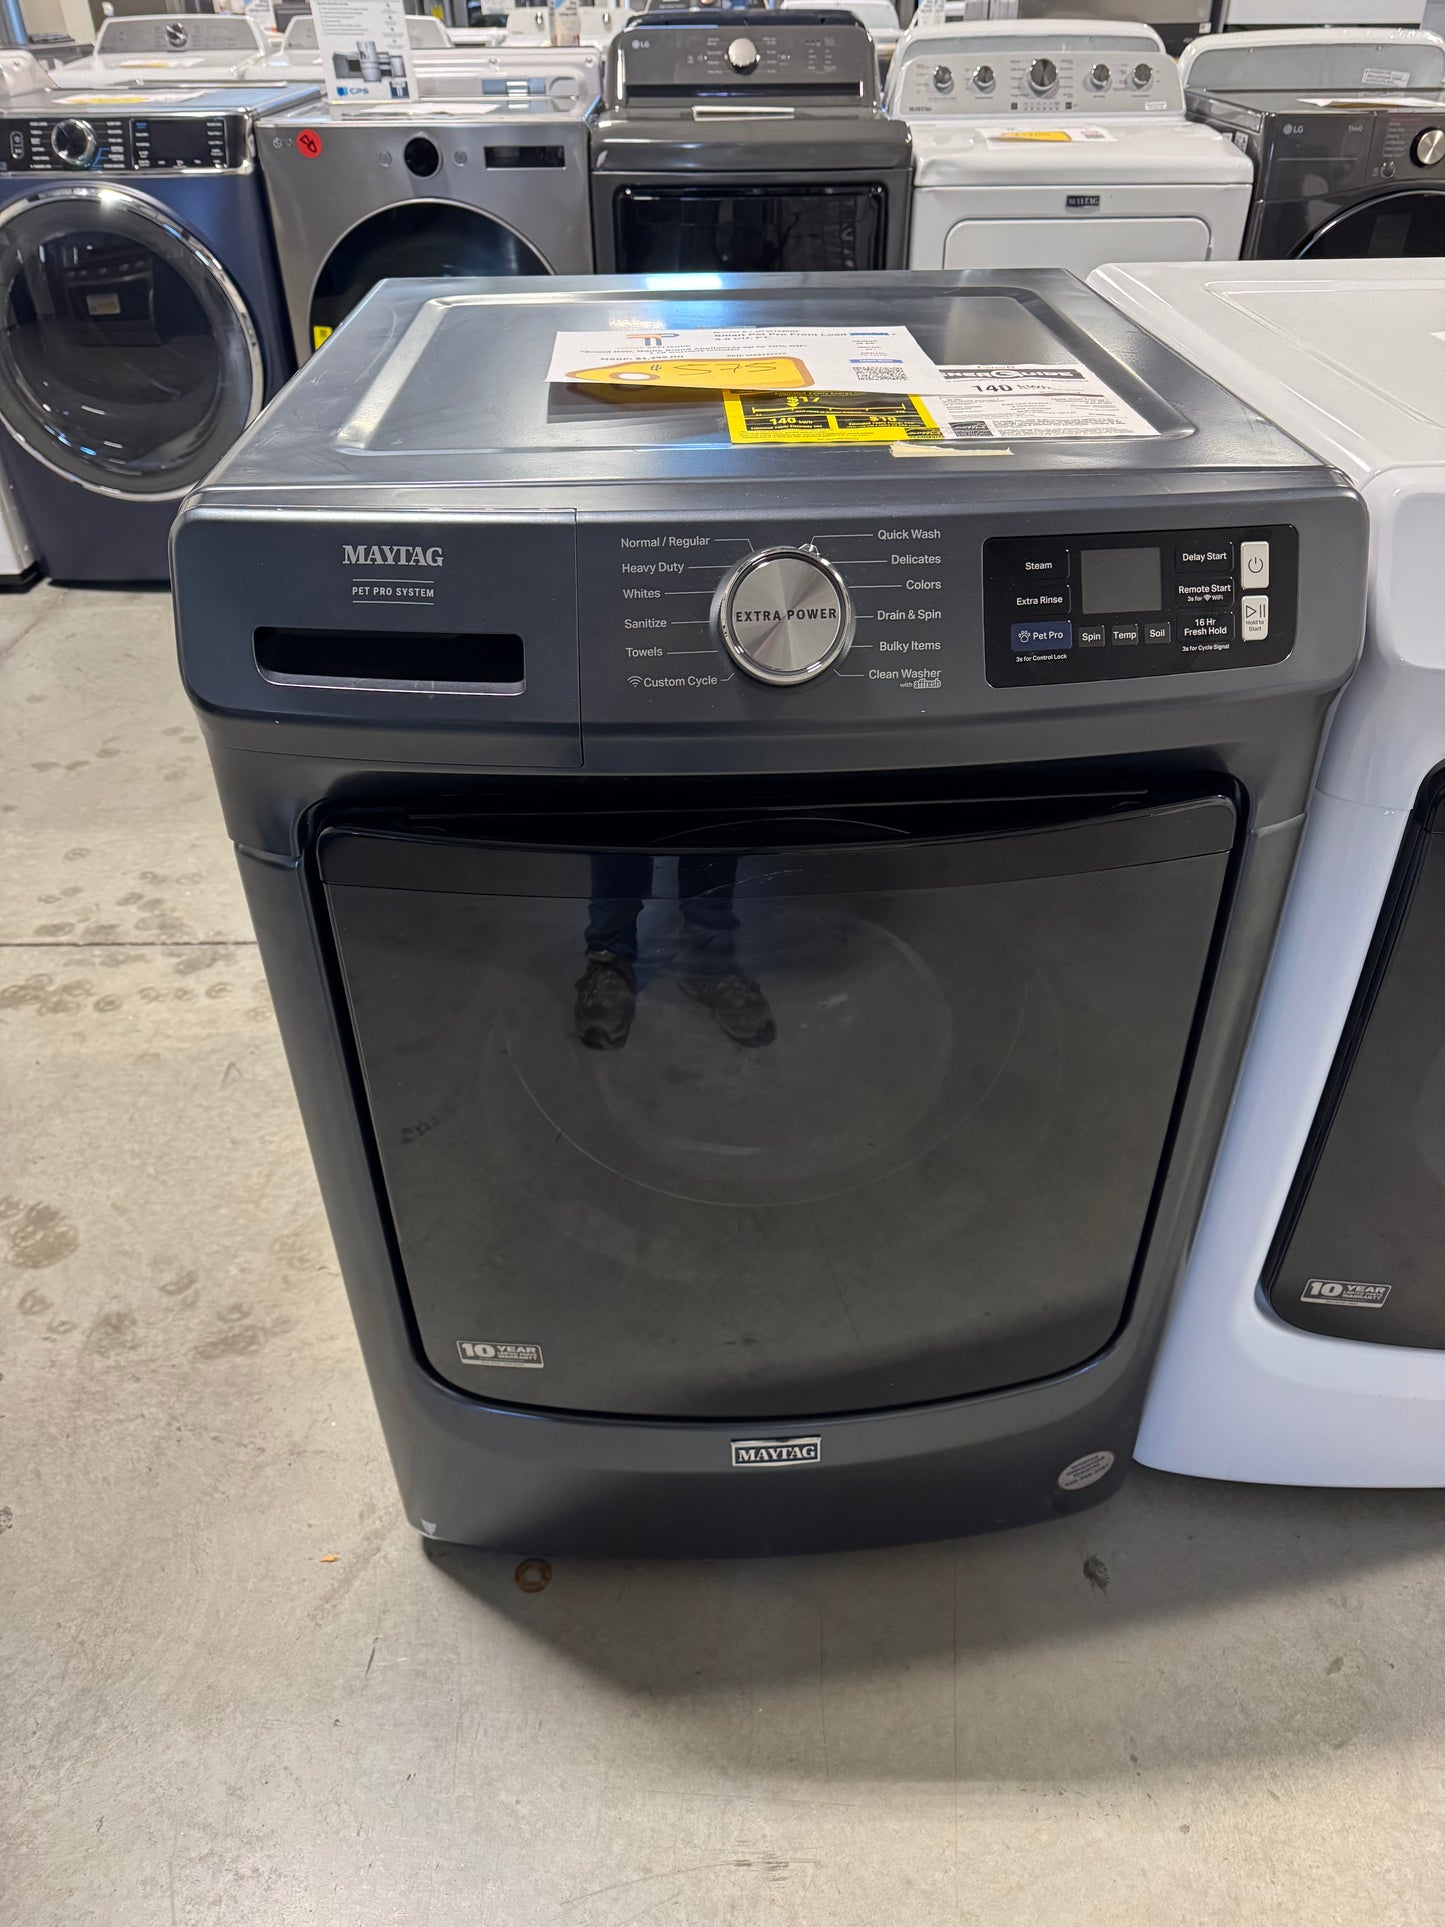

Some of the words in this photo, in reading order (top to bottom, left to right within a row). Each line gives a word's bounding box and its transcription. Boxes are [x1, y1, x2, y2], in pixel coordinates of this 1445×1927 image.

[1292, 126, 1304, 134] LG
[878, 530, 909, 540] Quick
[911, 530, 941, 539] Wash
[621, 537, 659, 548] Normal
[669, 536, 710, 547] Regular
[342, 545, 444, 567] MAYTAG
[891, 555, 941, 564] Delicates
[1182, 553, 1205, 562] Delay
[1207, 552, 1227, 561] Start
[622, 563, 656, 574] Heavy
[658, 562, 684, 574] Duty
[1025, 561, 1052, 570] Steam
[906, 580, 942, 590] Colors
[1178, 585, 1210, 594] Remote
[1211, 584, 1231, 593] Start
[352, 587, 370, 595] PET
[373, 587, 392, 596] PRO
[396, 588, 434, 597] SYSTEM
[623, 589, 661, 599] Whites
[1016, 596, 1038, 606] Extra
[1039, 595, 1063, 605] Rinse
[736, 610, 782, 622] EXTRA
[787, 608, 837, 620] POWER
[877, 610, 905, 620] Drain
[908, 611, 916, 620] &
[918, 610, 942, 621] Spin
[624, 618, 667, 629] Sanitize
[1195, 618, 1204, 627] 16
[1206, 618, 1216, 626] Hr
[1032, 632, 1046, 640] Pet
[1048, 631, 1063, 640] Pro
[1113, 630, 1137, 641] Temp
[1149, 629, 1166, 638] Soil
[1184, 627, 1206, 636] Fresh
[1207, 626, 1227, 635] Hold
[1082, 632, 1101, 643] Spin
[879, 642, 909, 652] Bulky
[911, 641, 941, 650] Items
[626, 647, 663, 657] Towels
[869, 670, 898, 679] Clean
[901, 668, 941, 679] Washer
[644, 677, 685, 688] Custom
[688, 675, 718, 688] Cycle
[913, 679, 942, 689] affresh
[1310, 1282, 1343, 1296] 10
[1346, 1285, 1386, 1293] YEAR
[462, 1343, 495, 1358] 10
[738, 1445, 816, 1462] MAYTAG
